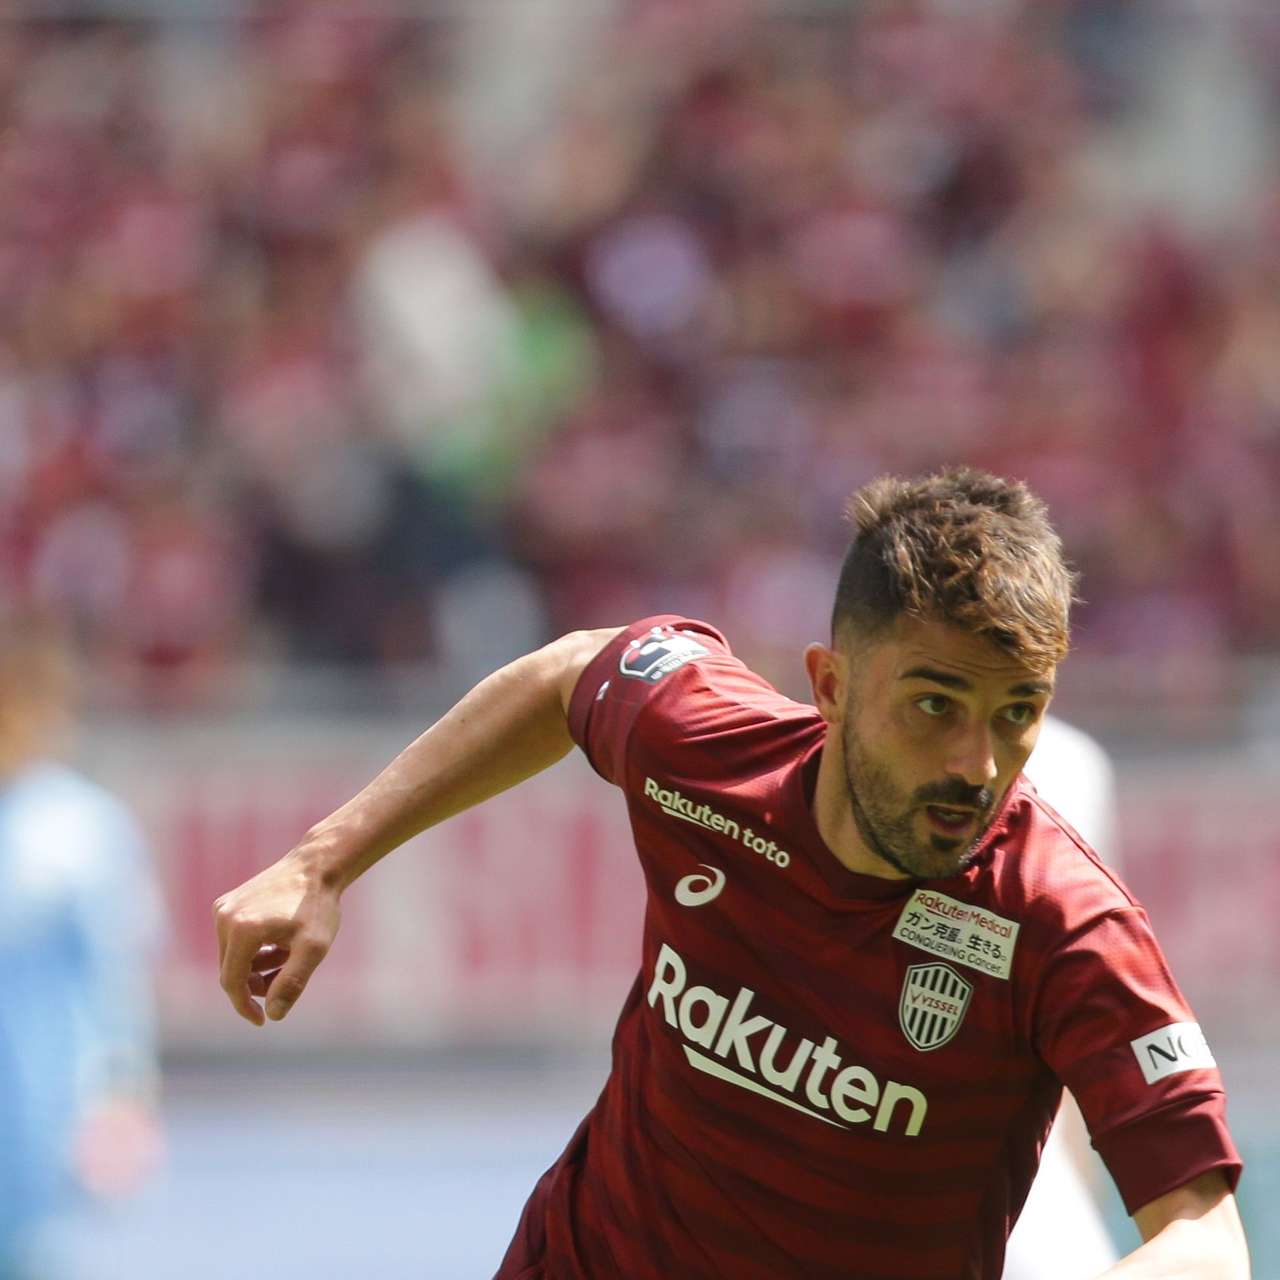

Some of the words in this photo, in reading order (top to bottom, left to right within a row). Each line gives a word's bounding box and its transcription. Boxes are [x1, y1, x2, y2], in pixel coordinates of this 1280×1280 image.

[644, 777, 740, 839] Rakuten
[742, 829, 790, 868] toto
[647, 943, 928, 1136] Rakuten
